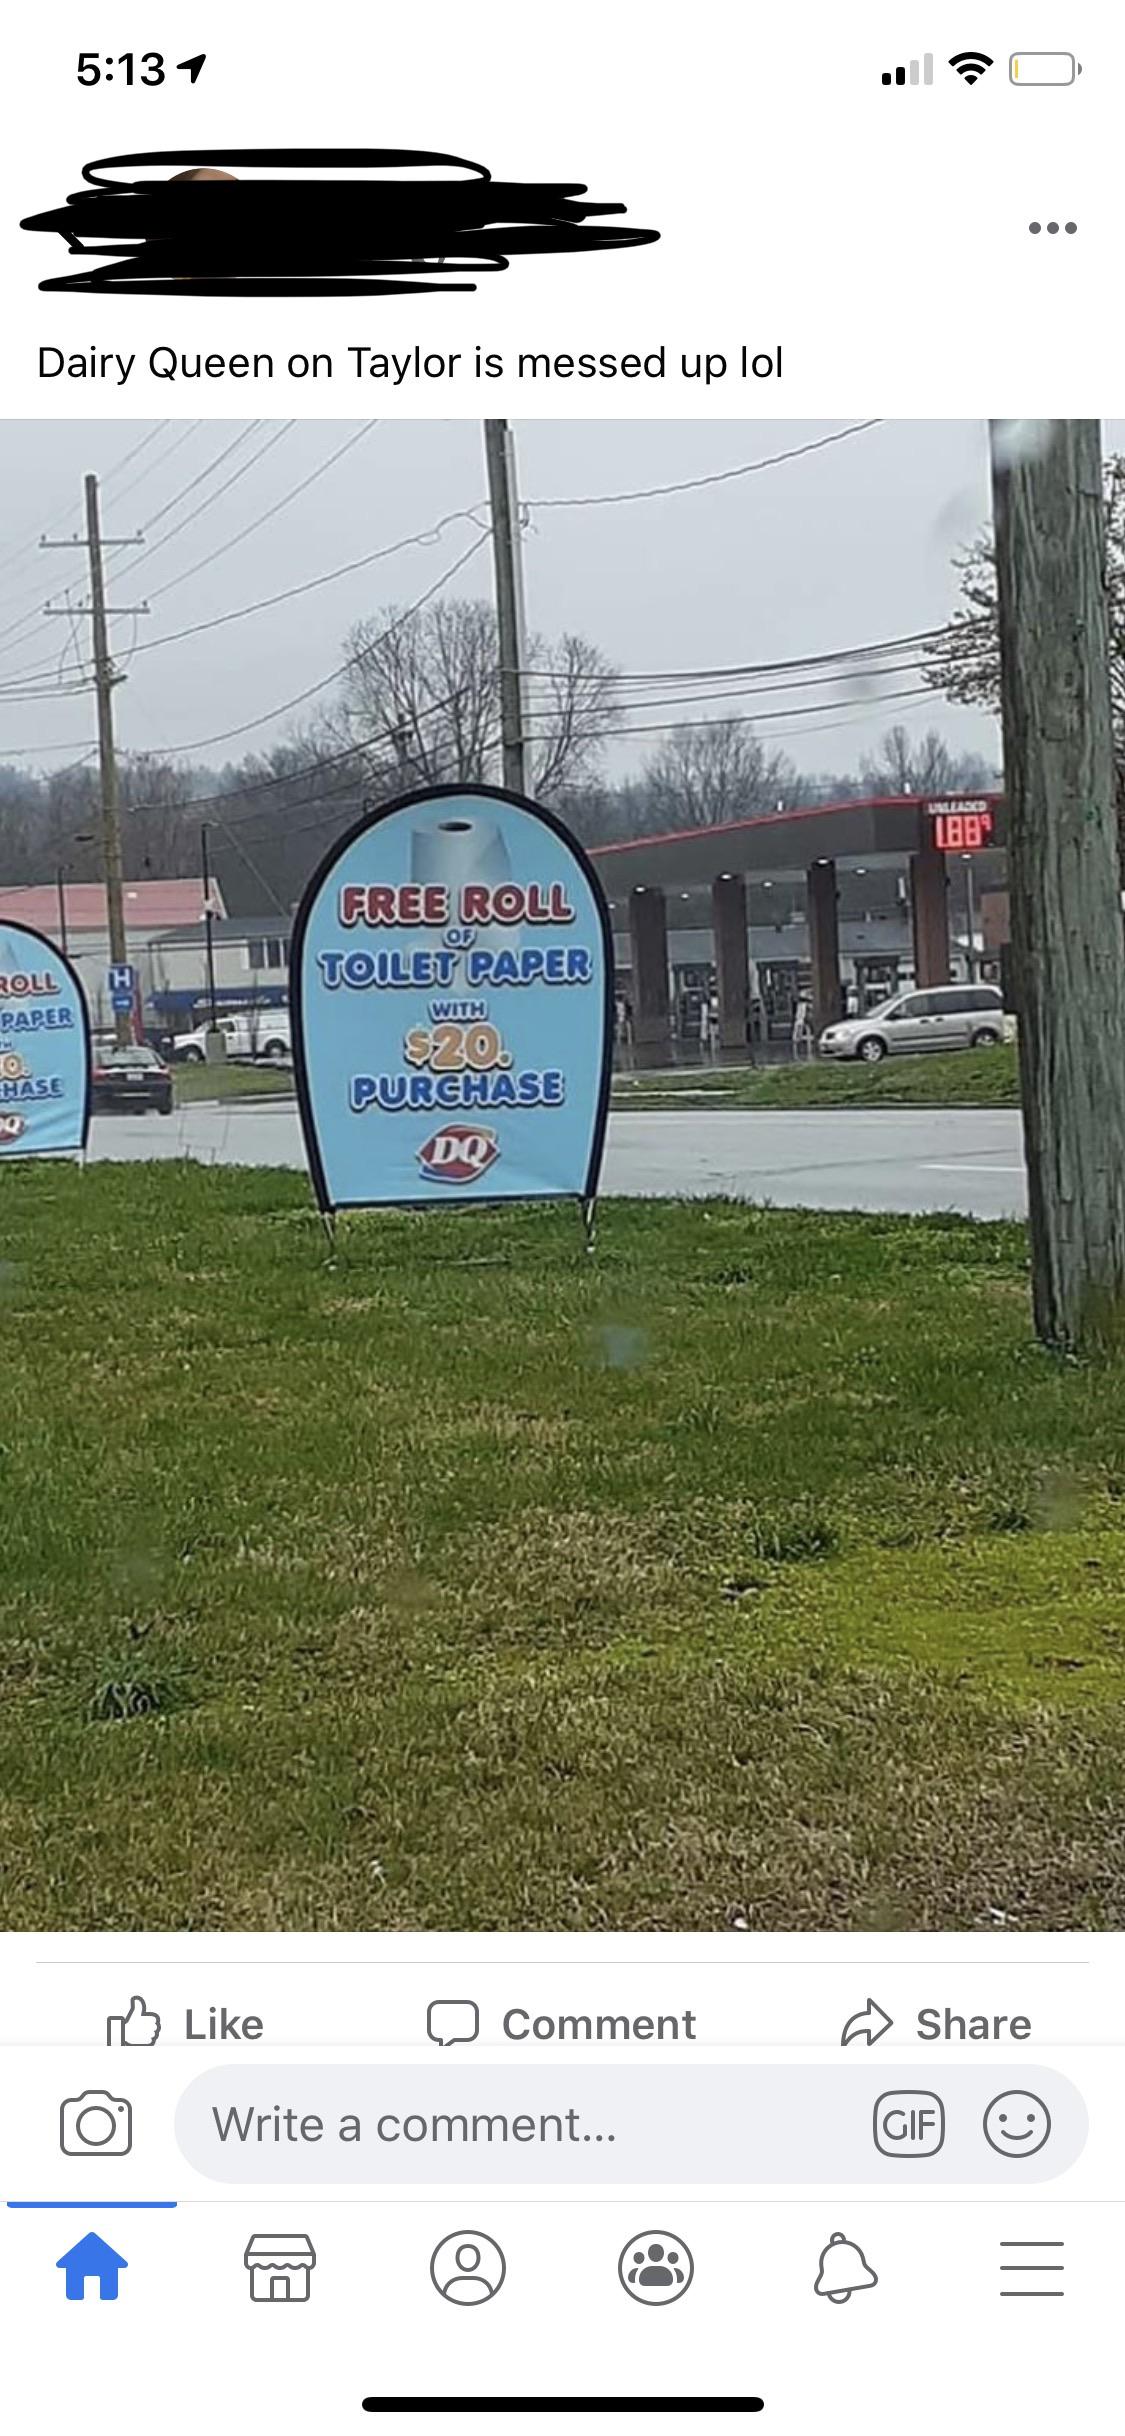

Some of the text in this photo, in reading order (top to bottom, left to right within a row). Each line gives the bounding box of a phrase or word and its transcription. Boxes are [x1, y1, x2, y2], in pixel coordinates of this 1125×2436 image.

[928, 801, 987, 814] UNLEADED
[341, 884, 576, 925] FREE ROLL
[445, 928, 477, 949] OF
[113, 967, 131, 988] H
[318, 947, 593, 988] TOILET PAPER
[0, 1007, 73, 1031] PAPER
[429, 1000, 488, 1021] WITH
[350, 1072, 566, 1110] PURCHASE
[430, 1136, 489, 1167] DQ
